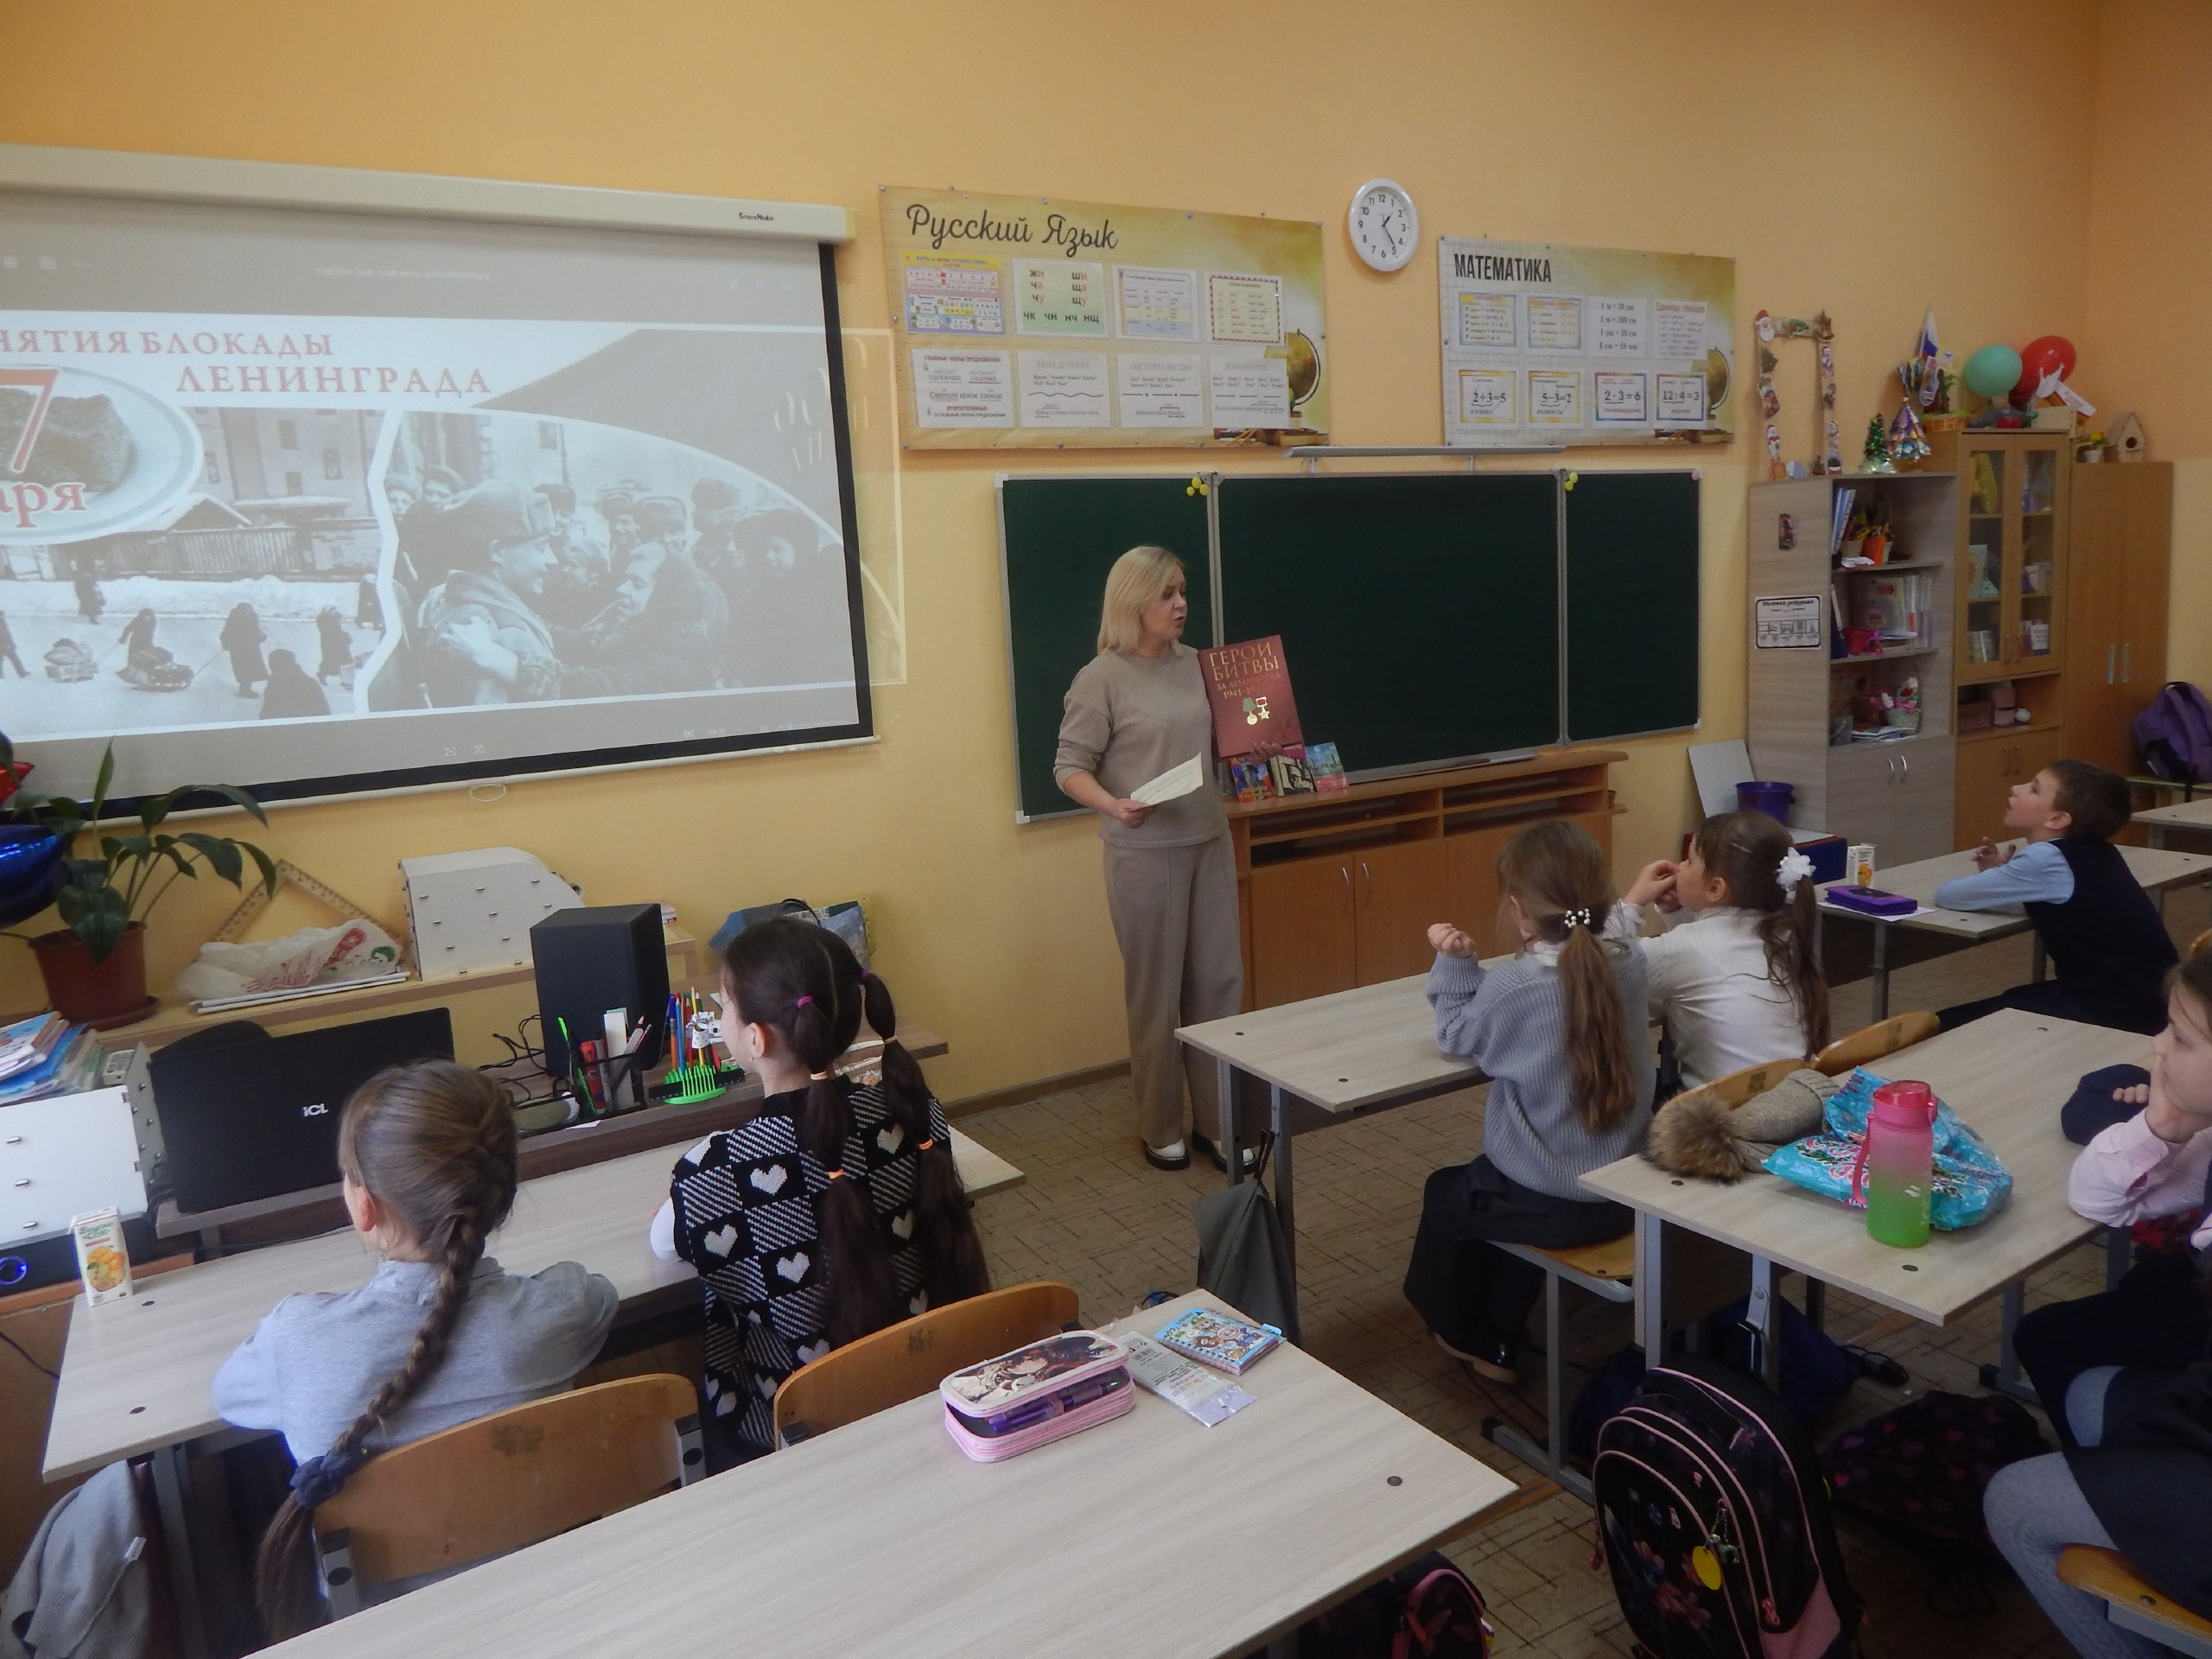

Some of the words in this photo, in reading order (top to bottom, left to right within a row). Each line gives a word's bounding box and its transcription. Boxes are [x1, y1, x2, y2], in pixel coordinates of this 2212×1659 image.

[1369, 197, 1375, 206] 11
[1391, 199, 1395, 207] 1
[1362, 207, 1370, 215] 10
[1398, 209, 1403, 218] 2
[1358, 220, 1363, 229] 9
[1402, 224, 1406, 232] 3
[906, 204, 1033, 250] Русский
[1041, 214, 1118, 257] Язык
[1363, 234, 1368, 243] 8
[1371, 245, 1376, 254] 7
[1382, 250, 1387, 258] 6
[1392, 246, 1397, 255] 5
[1454, 253, 1552, 283] МАТЕМАТИКА
[1029, 270, 1045, 278] жи
[1071, 272, 1088, 281] ши
[1031, 282, 1043, 290] ча
[1072, 284, 1087, 293] ща
[1032, 294, 1045, 304] чу
[1072, 297, 1087, 307] щу
[1084, 315, 1099, 324] нщ
[140, 332, 334, 359] БЛОКАДЫ
[176, 366, 492, 398] ЛЕНИНГРАДА
[1210, 642, 1272, 667] ГЕРОИ
[1213, 656, 1280, 682] БИТВЫ
[1217, 683, 1228, 691] ЗА
